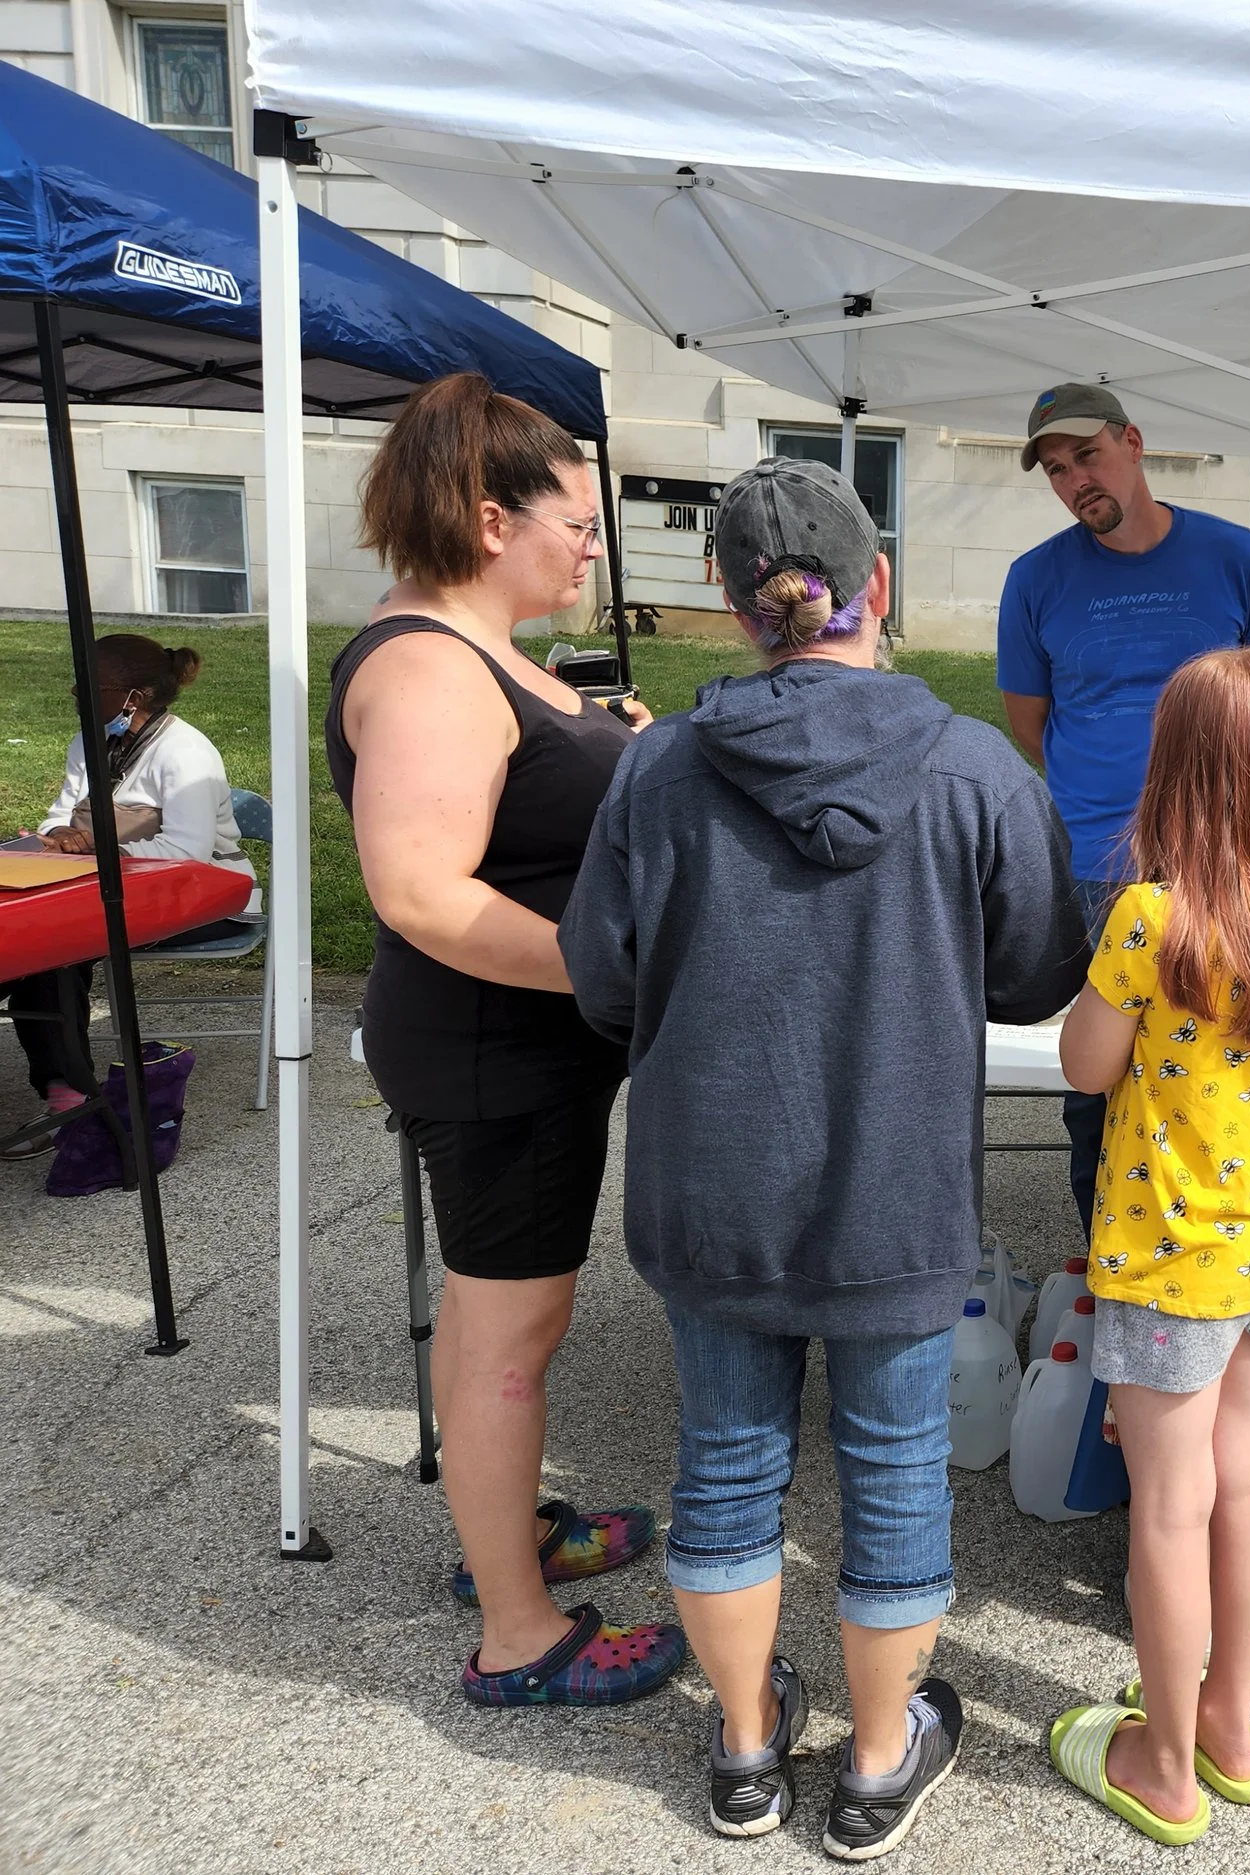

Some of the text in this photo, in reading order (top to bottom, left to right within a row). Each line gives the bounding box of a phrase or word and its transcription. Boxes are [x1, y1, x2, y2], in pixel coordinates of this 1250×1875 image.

[121, 249, 236, 298] GUIDESMAN
[663, 505, 715, 532] JOIN U
[1088, 592, 1190, 612] INDIANAPOLIS
